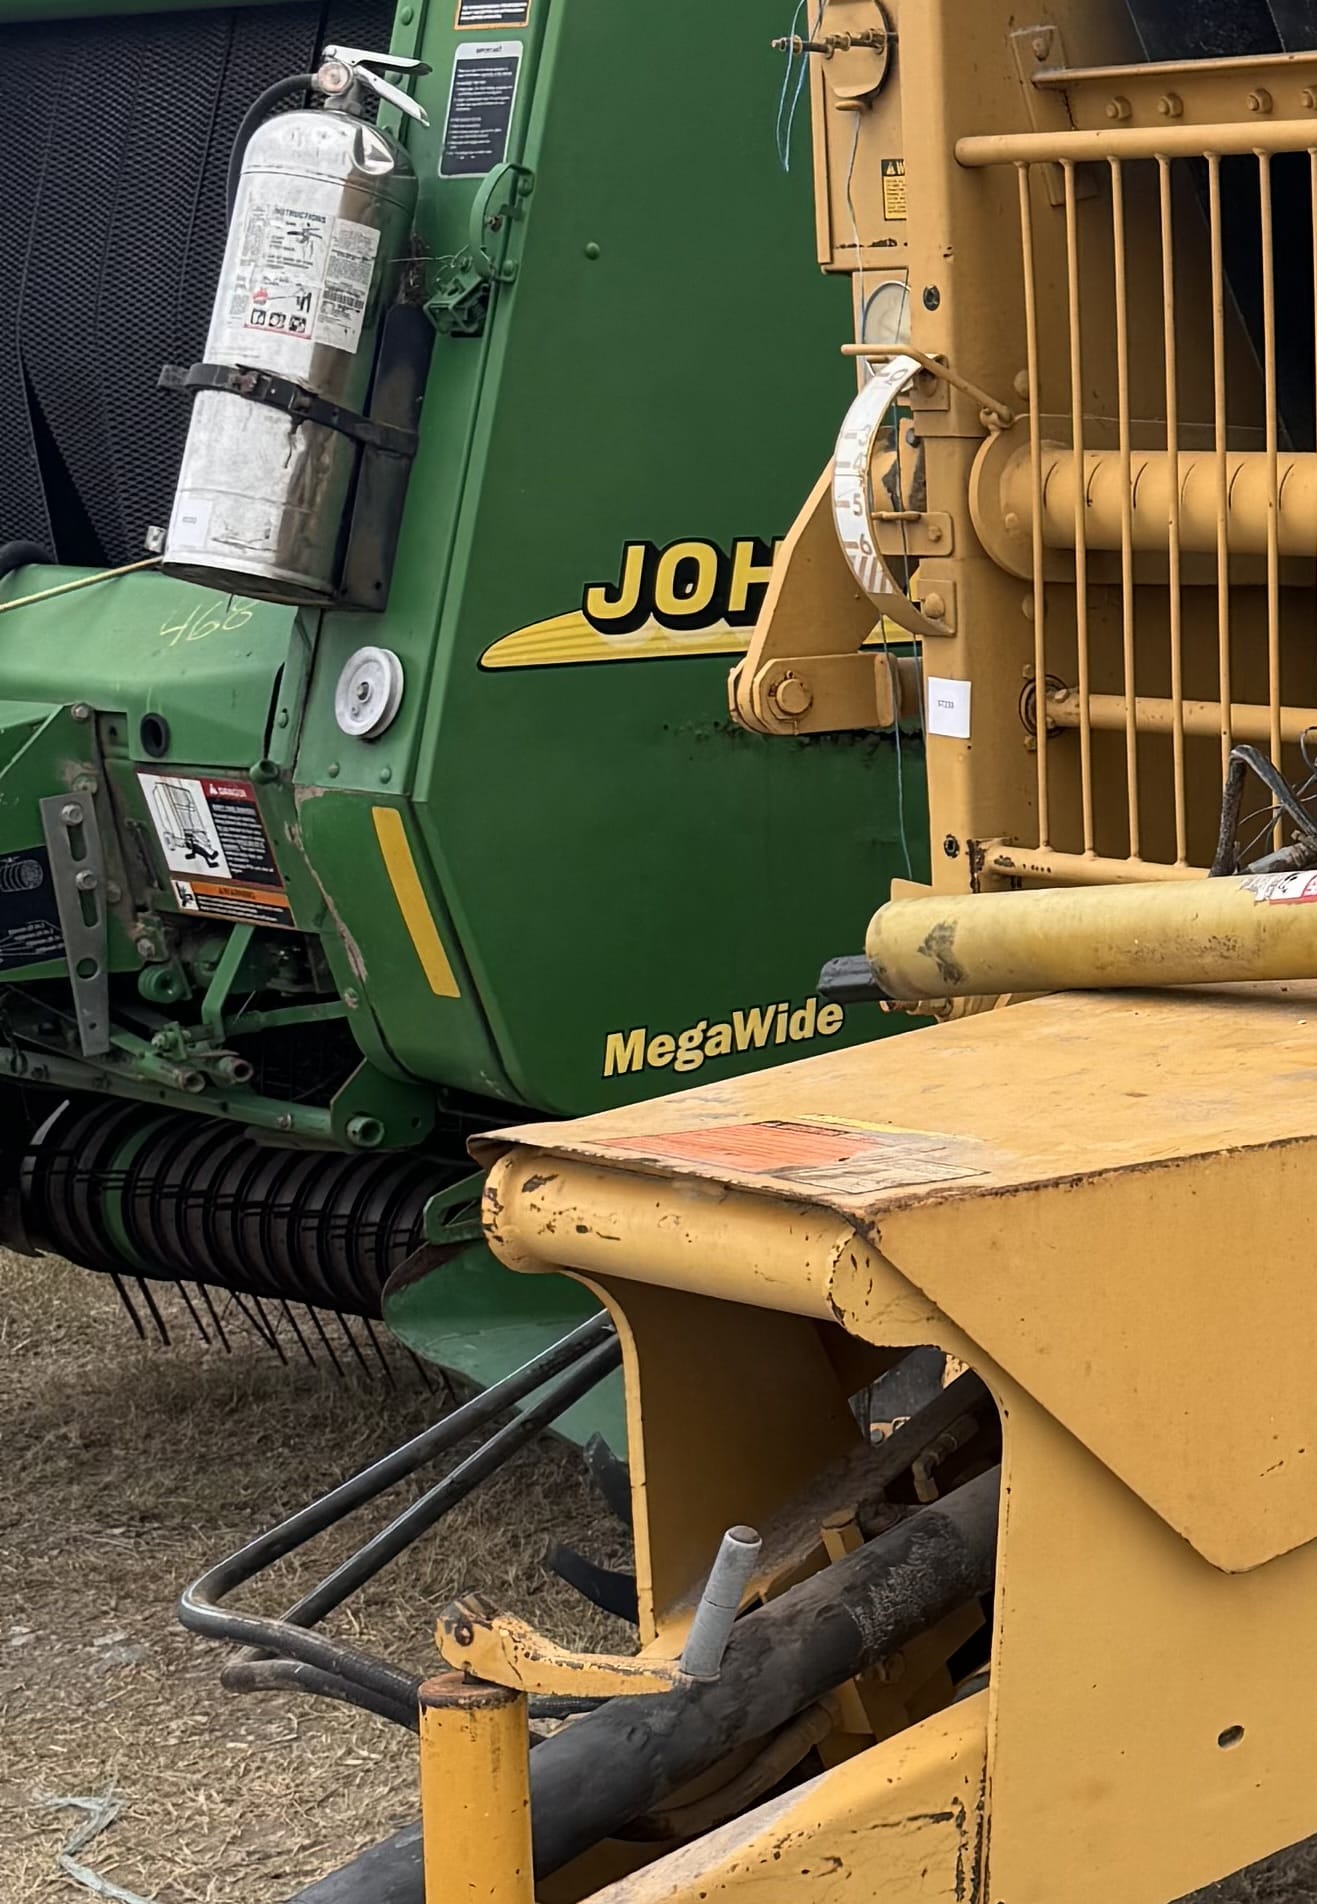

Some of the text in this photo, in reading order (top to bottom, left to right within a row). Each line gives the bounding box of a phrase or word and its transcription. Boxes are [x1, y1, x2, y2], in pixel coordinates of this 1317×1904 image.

[853, 493, 863, 516] 5
[859, 532, 872, 555] 6
[602, 997, 844, 1078] MegaWide
